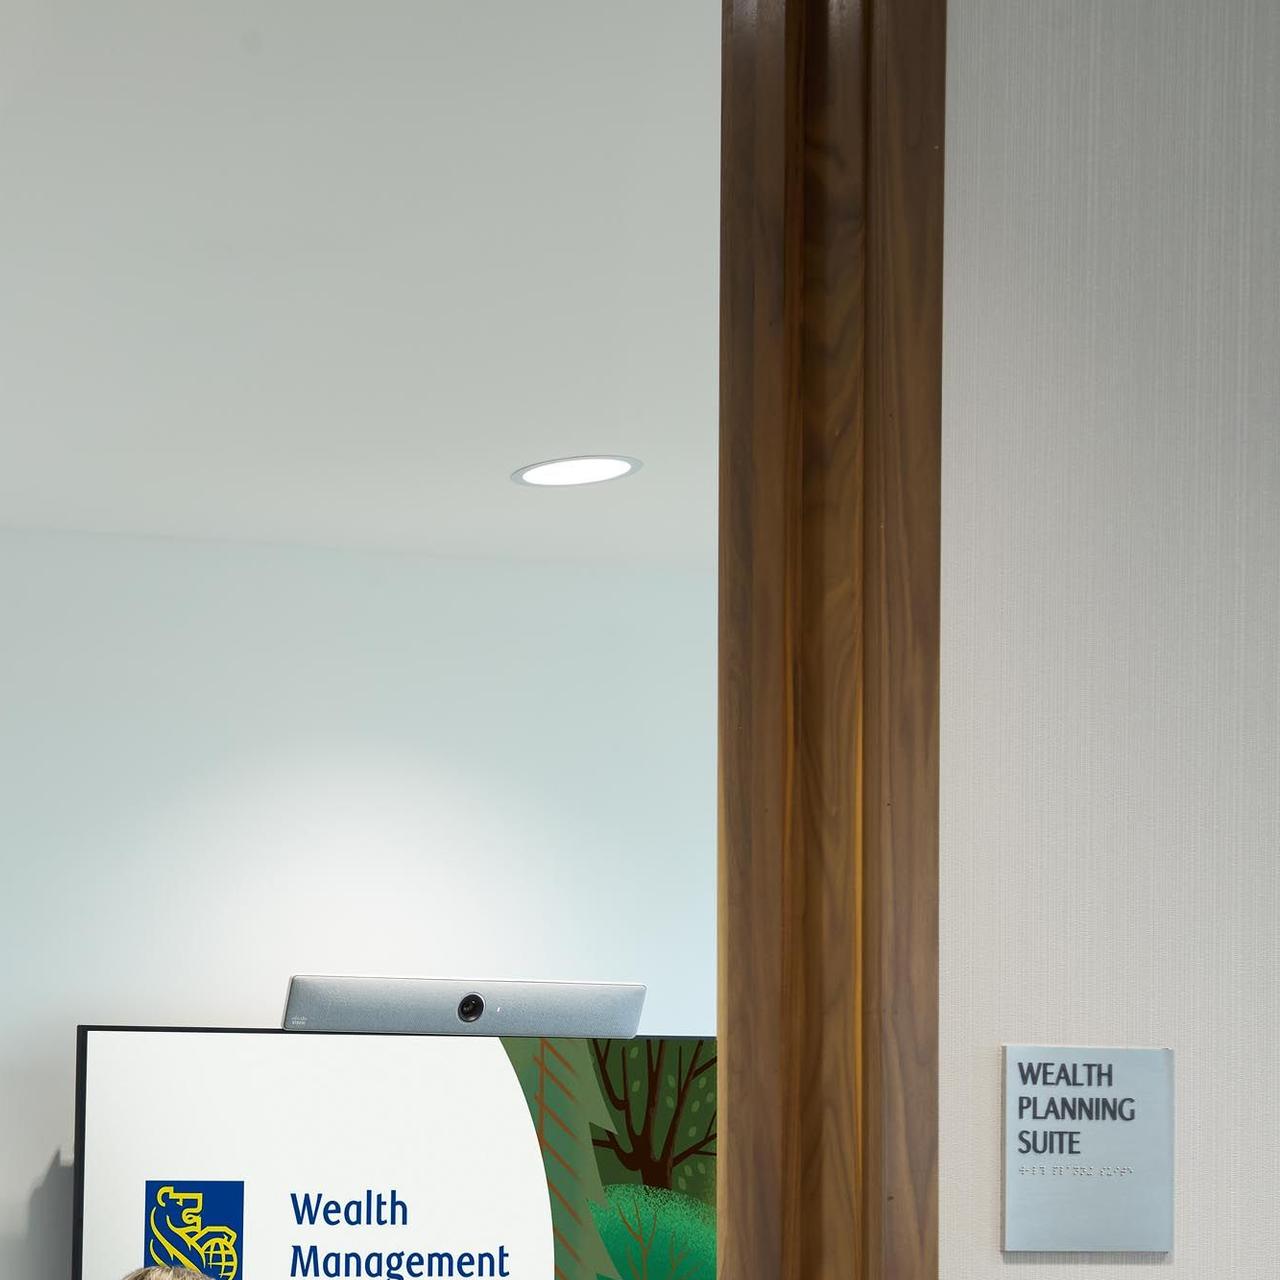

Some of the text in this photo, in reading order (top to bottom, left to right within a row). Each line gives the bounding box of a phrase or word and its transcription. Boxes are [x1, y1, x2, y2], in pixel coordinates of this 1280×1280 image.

[1018, 1063, 1112, 1086] WEALTH
[1019, 1097, 1135, 1121] PLANNING
[1018, 1131, 1080, 1154] SUITE
[291, 1190, 407, 1225] Wealth
